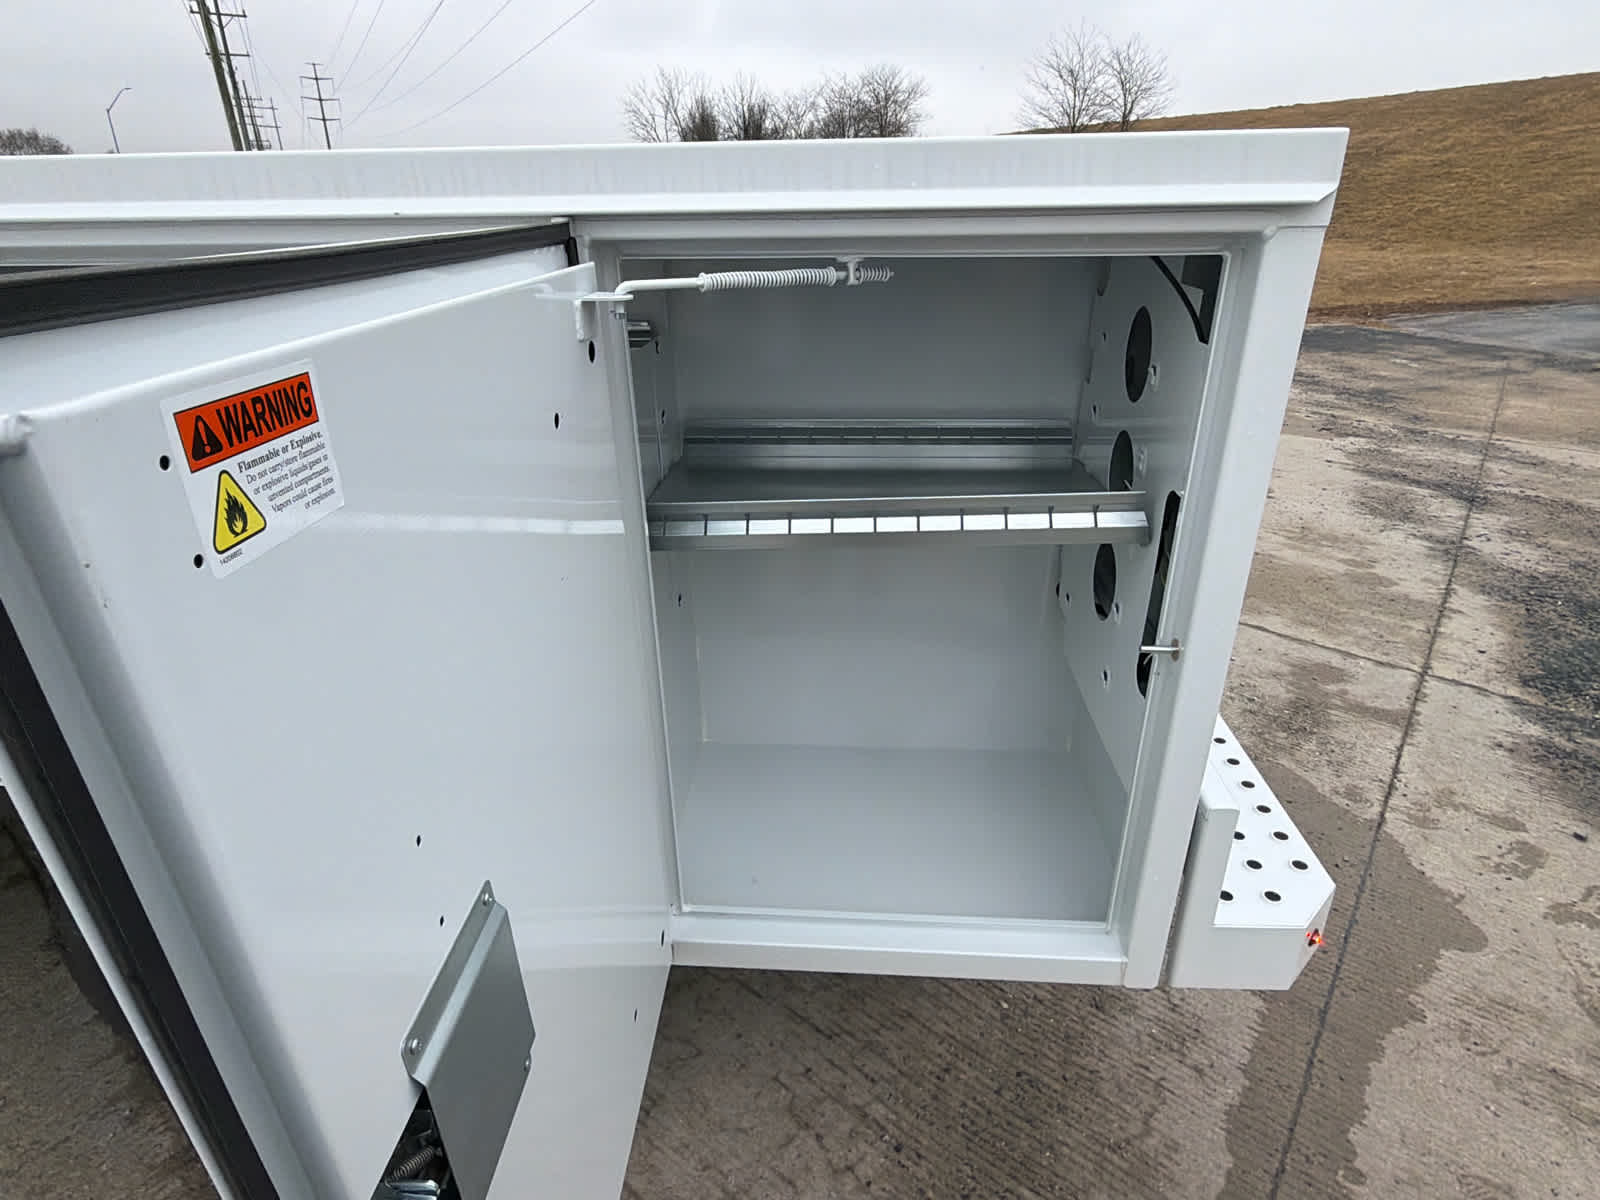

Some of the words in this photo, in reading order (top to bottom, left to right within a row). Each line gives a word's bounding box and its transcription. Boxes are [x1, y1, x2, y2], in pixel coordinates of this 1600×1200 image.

[216, 381, 313, 449] WARNING
[238, 448, 280, 473] Flammable
[281, 445, 289, 454] or
[246, 474, 257, 484] Do
[257, 469, 268, 480] not
[253, 486, 261, 495] or
